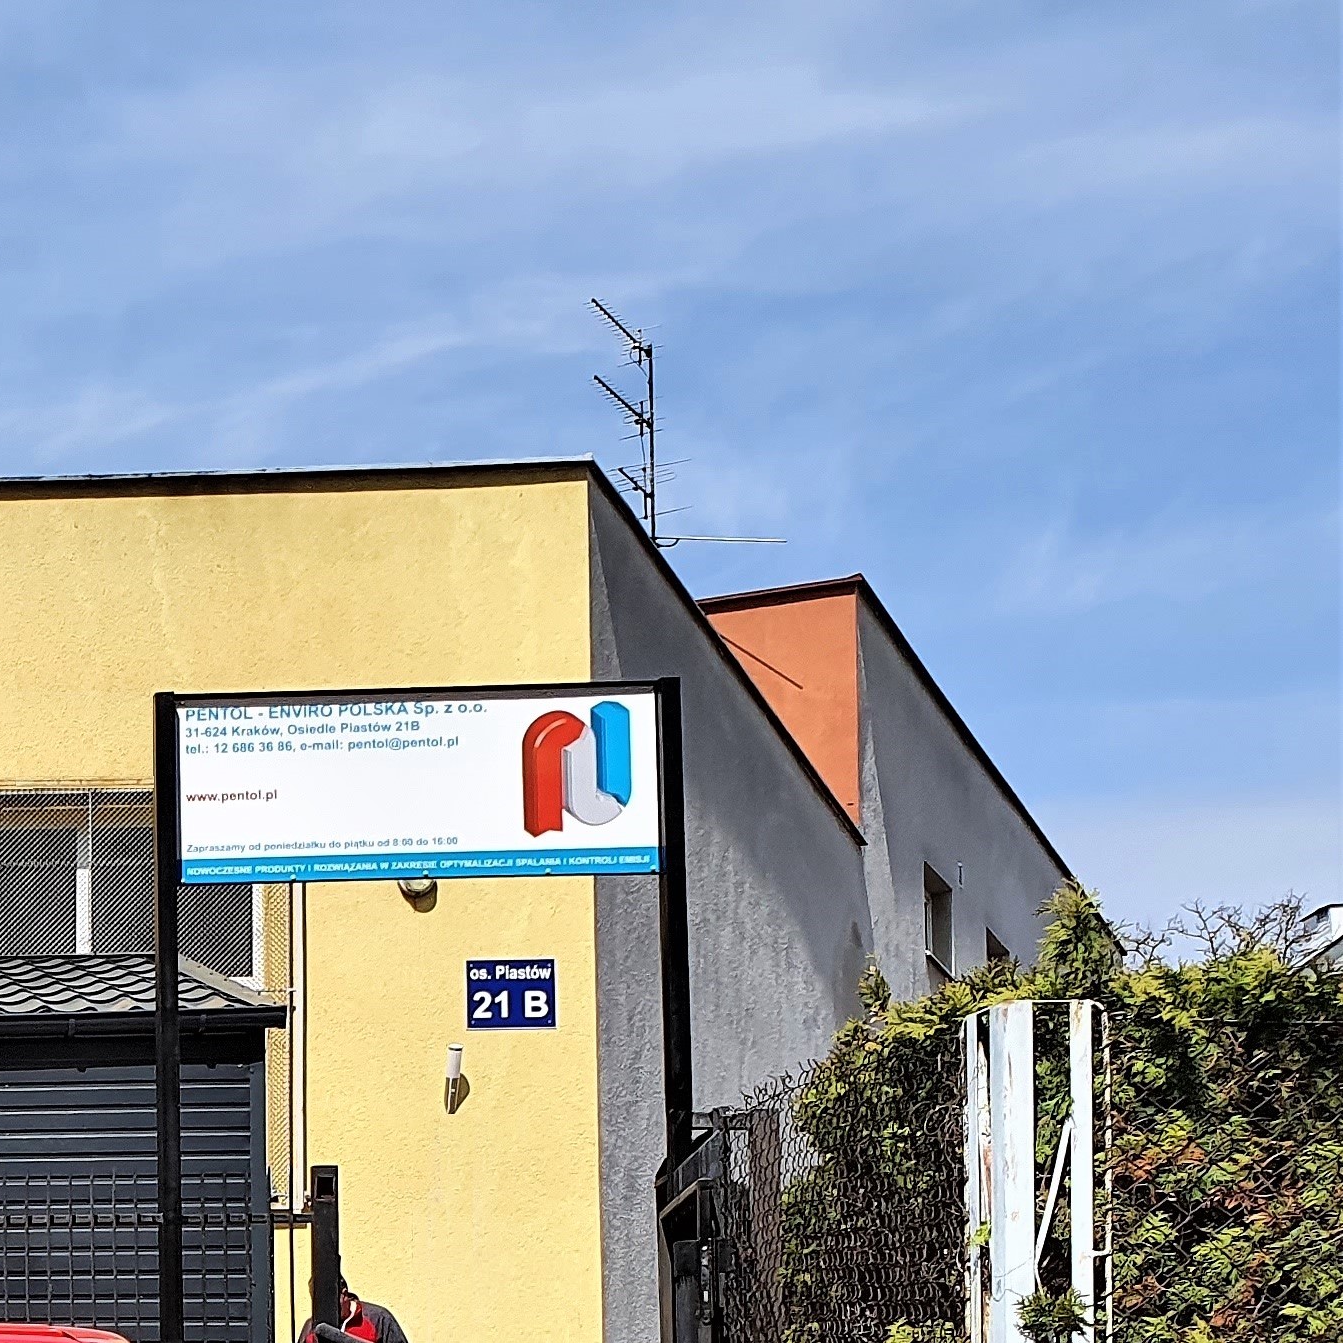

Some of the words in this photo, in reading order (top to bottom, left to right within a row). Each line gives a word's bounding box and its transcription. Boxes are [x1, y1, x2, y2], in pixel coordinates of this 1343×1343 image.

[185, 706, 253, 721] PENTOL
[268, 704, 333, 719] ENVIRO
[338, 701, 409, 717] POLSKA
[413, 701, 439, 717] Sp.
[443, 703, 453, 714] z
[457, 702, 488, 714] o.o.
[185, 726, 227, 738] 31-624
[231, 724, 283, 738] Kraków,
[287, 723, 336, 735] Osiedle
[340, 721, 392, 733] Piastów
[395, 720, 420, 732] 21B
[185, 743, 209, 755] tel.:
[214, 742, 229, 753] 12
[232, 742, 255, 753] 686
[258, 741, 274, 752] 36
[277, 741, 296, 753] 86,
[300, 738, 344, 751] e-mail:
[347, 735, 459, 752] pentol@pentol.pl
[185, 789, 278, 804] www.pentol.pl
[186, 843, 246, 854] Zapraszamy
[248, 842, 261, 851] od
[328, 840, 342, 849] do
[344, 839, 375, 850] piątku
[377, 838, 390, 847] od
[416, 838, 429, 846] do
[186, 865, 253, 876] NOWOCZESNE
[254, 864, 307, 874] PRODUKTY
[469, 968, 492, 980] os.
[495, 964, 552, 980] Piastów
[472, 990, 509, 1019] 21
[524, 990, 549, 1018] B
